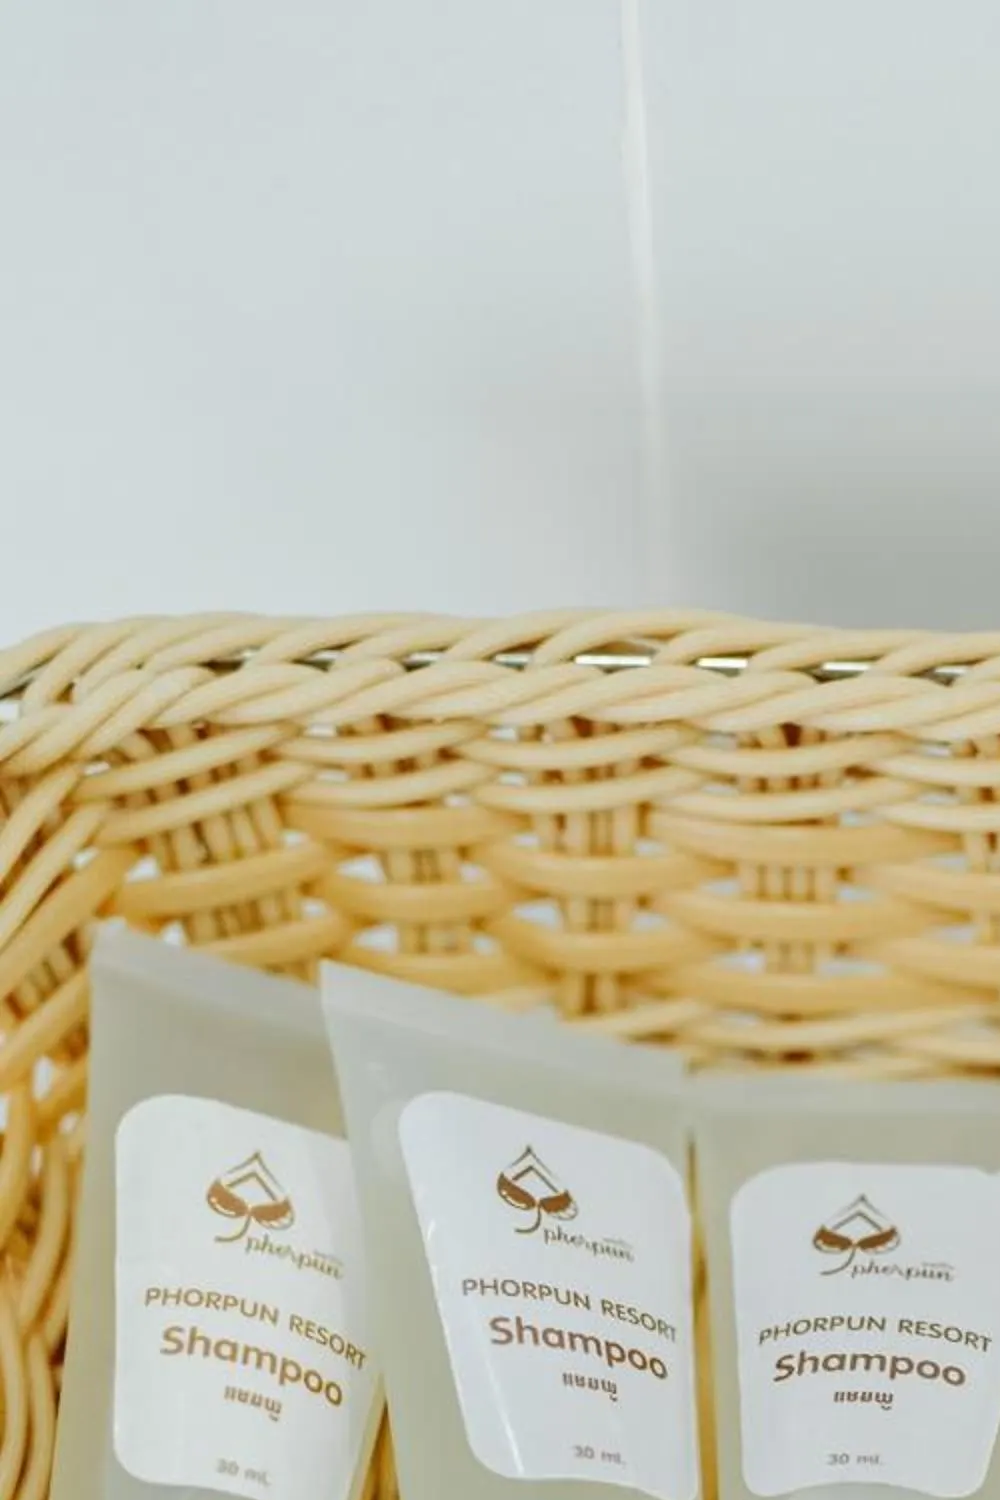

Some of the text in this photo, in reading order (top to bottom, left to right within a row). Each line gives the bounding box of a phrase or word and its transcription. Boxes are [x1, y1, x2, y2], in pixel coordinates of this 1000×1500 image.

[144, 1287, 368, 1368] PHORPUN RESORT
[461, 1278, 677, 1343] PHORPUN RESORT
[490, 1316, 668, 1380] Shampoo
[758, 1315, 992, 1352] PHORPUN RESORT
[160, 1325, 344, 1406] Shampoo
[773, 1350, 966, 1386] Shampoo
[216, 1459, 240, 1476] 30
[573, 1445, 595, 1460] 30
[828, 1453, 851, 1466] 30
